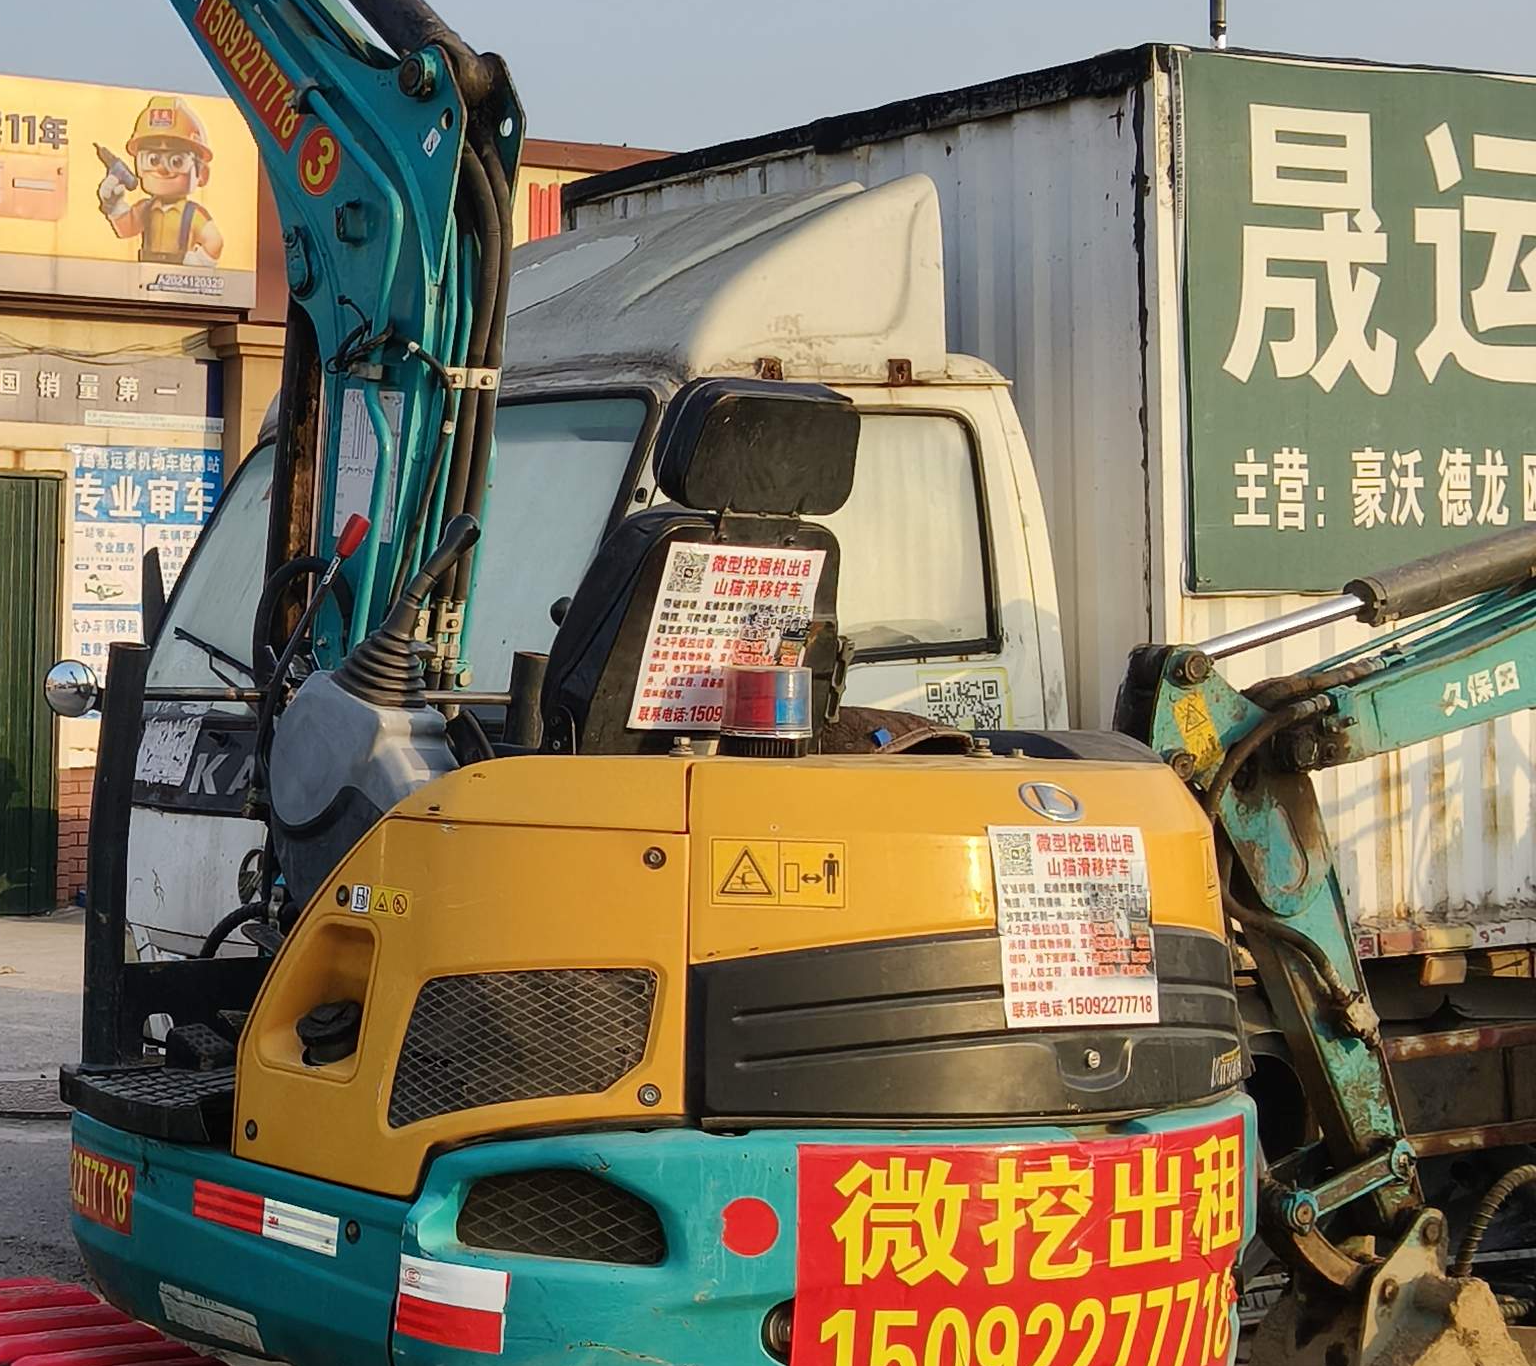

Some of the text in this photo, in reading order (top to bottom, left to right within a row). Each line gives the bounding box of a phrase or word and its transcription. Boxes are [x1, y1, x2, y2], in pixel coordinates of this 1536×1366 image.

[306, 137, 335, 186] 3
[75, 472, 215, 521] 专业审车
[1351, 446, 1425, 528] 豪沃
[1438, 447, 1509, 527] 德龙
[711, 555, 811, 578] 微型挖掘机出租
[713, 578, 803, 598] 山猫滑移铲车
[1442, 660, 1522, 717] 久保田
[1035, 833, 1135, 853] 微型挖掘机出租
[1047, 857, 1131, 878] 山猫滑移铲车
[831, 1134, 1241, 1286] 微挖出租
